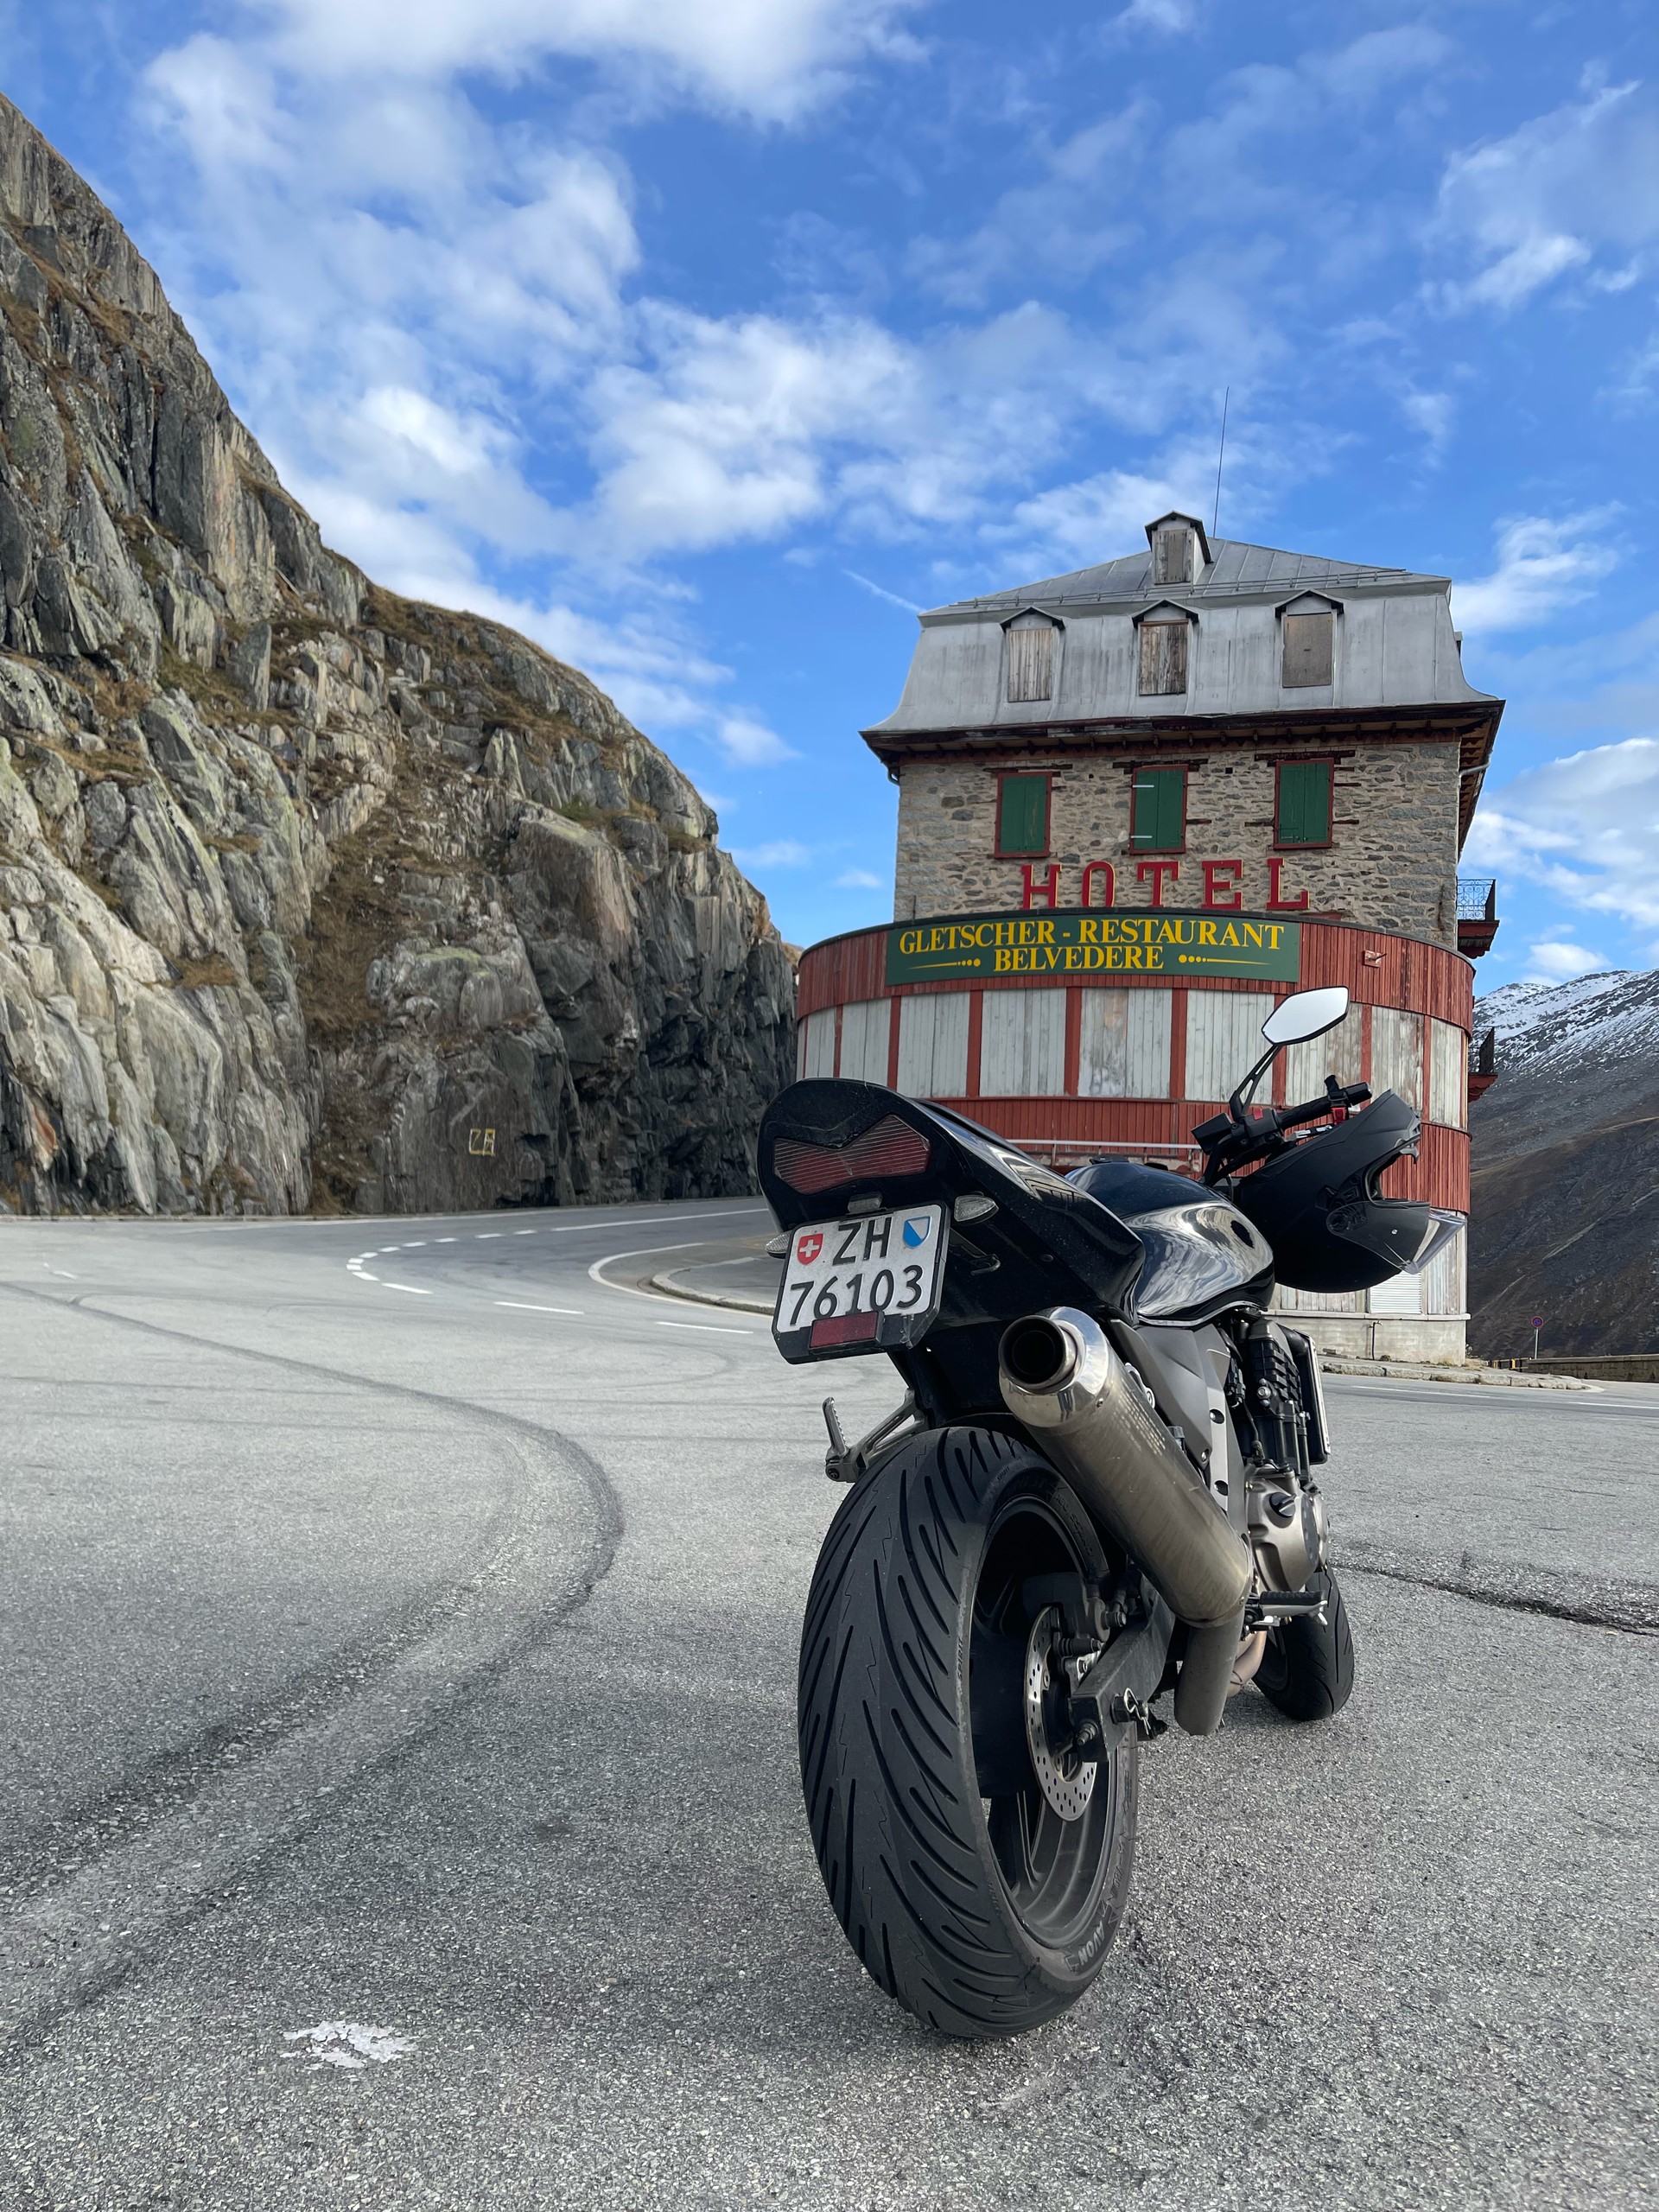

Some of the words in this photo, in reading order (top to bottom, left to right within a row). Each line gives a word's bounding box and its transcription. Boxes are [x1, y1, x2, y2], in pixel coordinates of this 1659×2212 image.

[1020, 858, 1309, 910] HOTEL
[899, 920, 1055, 955] GLETSCHER
[1077, 918, 1285, 950] RESTAURANT
[994, 945, 1164, 972] BELVEDERE
[832, 1217, 892, 1266] ZH
[790, 1265, 924, 1325] 76103
[1077, 1921, 1106, 1967] AVON
